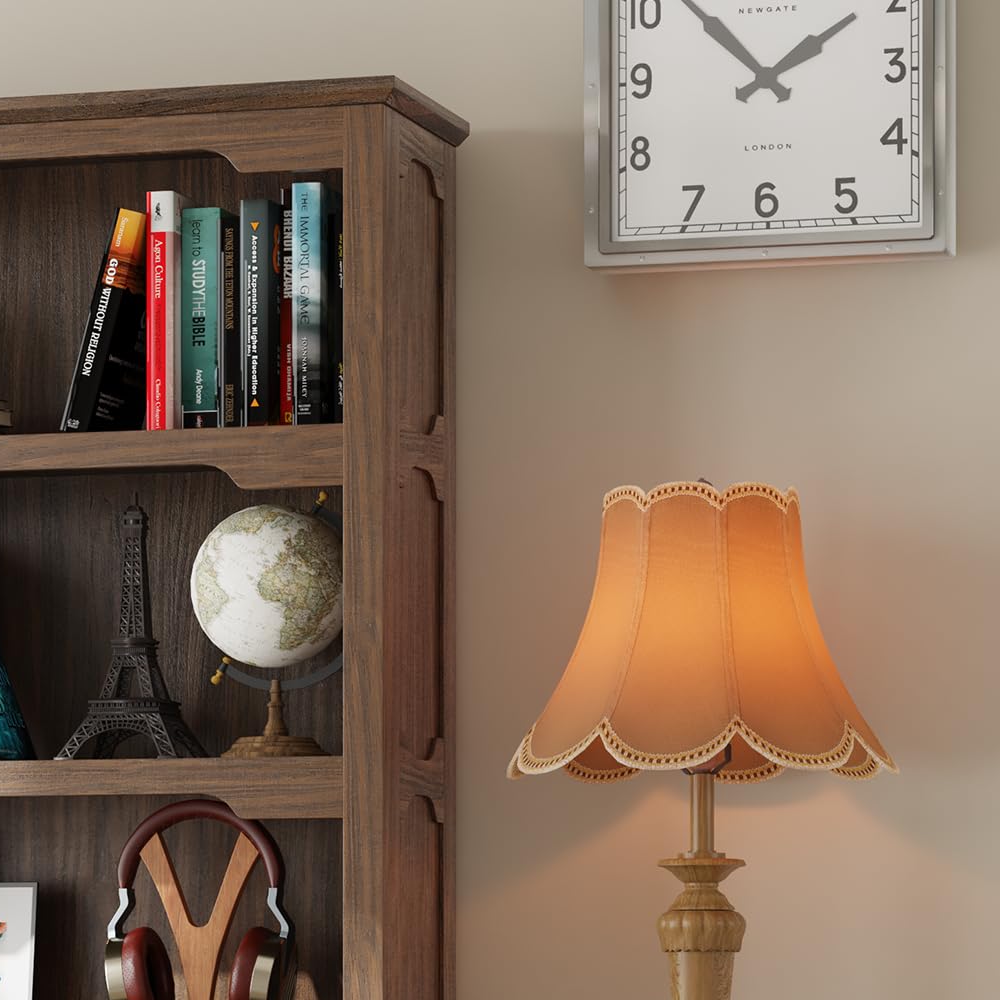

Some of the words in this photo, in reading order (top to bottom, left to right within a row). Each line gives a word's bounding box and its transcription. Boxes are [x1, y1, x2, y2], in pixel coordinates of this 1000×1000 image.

[630, 0, 662, 30] 10
[738, 5, 798, 14] NEWGATE
[630, 63, 653, 100] 9
[883, 48, 907, 84] 3
[744, 143, 793, 152] LONDON
[879, 117, 909, 155] 4
[630, 135, 651, 172] 8
[682, 185, 706, 222] 7
[754, 182, 779, 219] 6
[834, 177, 859, 215] 5
[191, 219, 204, 244] learn
[225, 228, 234, 251] SAYINGS
[154, 239, 163, 263] Agon
[192, 246, 203, 257] to
[225, 251, 234, 268] FROM
[251, 235, 259, 264] Access
[298, 215, 310, 281] IMMORTAL
[105, 258, 119, 285] GOD
[155, 264, 164, 299] Culture
[225, 267, 234, 279] THE
[251, 265, 258, 273] &
[283, 256, 292, 299] BAZAAR
[250, 274, 259, 315] Expansion
[299, 285, 310, 325] GAME
[94, 287, 112, 337] WITHOUT
[225, 298, 234, 330] MOUNTAINS
[81, 332, 100, 377] RELIGION
[250, 326, 259, 354] Higher
[194, 368, 203, 385] Andy
[251, 355, 259, 396] Education
[195, 385, 203, 405] Deane
